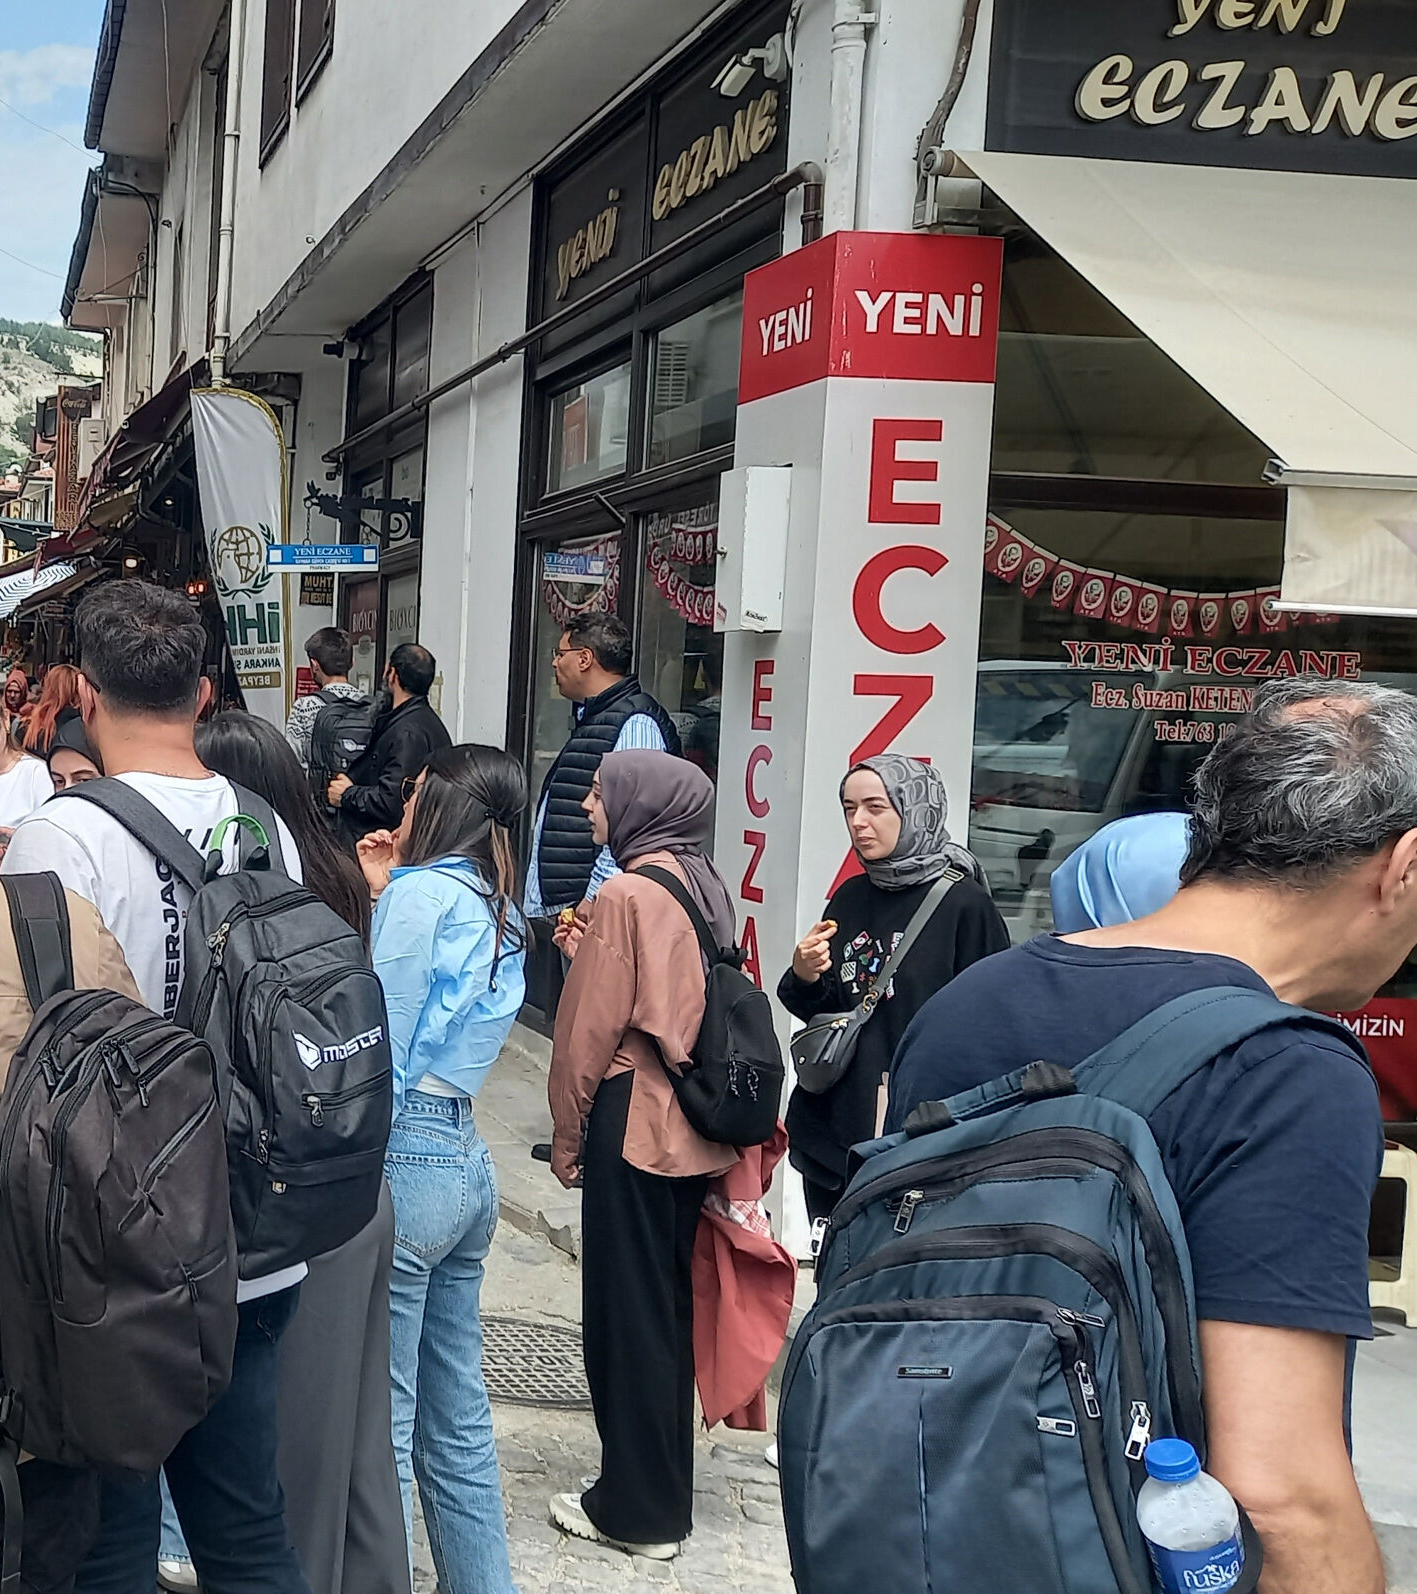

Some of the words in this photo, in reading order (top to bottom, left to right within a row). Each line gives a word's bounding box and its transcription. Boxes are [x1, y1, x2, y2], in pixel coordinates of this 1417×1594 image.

[1074, 53, 1417, 141] ECZANE
[652, 90, 779, 221] ECZANE
[758, 286, 814, 357] YENİ
[854, 283, 984, 337] YENİ
[317, 547, 351, 556] ECZANE
[304, 575, 333, 588] MUHT
[1062, 636, 1174, 673] YENİ
[1184, 644, 1362, 680] ECZANE
[1091, 682, 1129, 708] Ecz.
[1132, 683, 1187, 711] Suzan
[740, 660, 775, 990] ECZA
[1336, 1012, 1405, 1037] MİZİN
